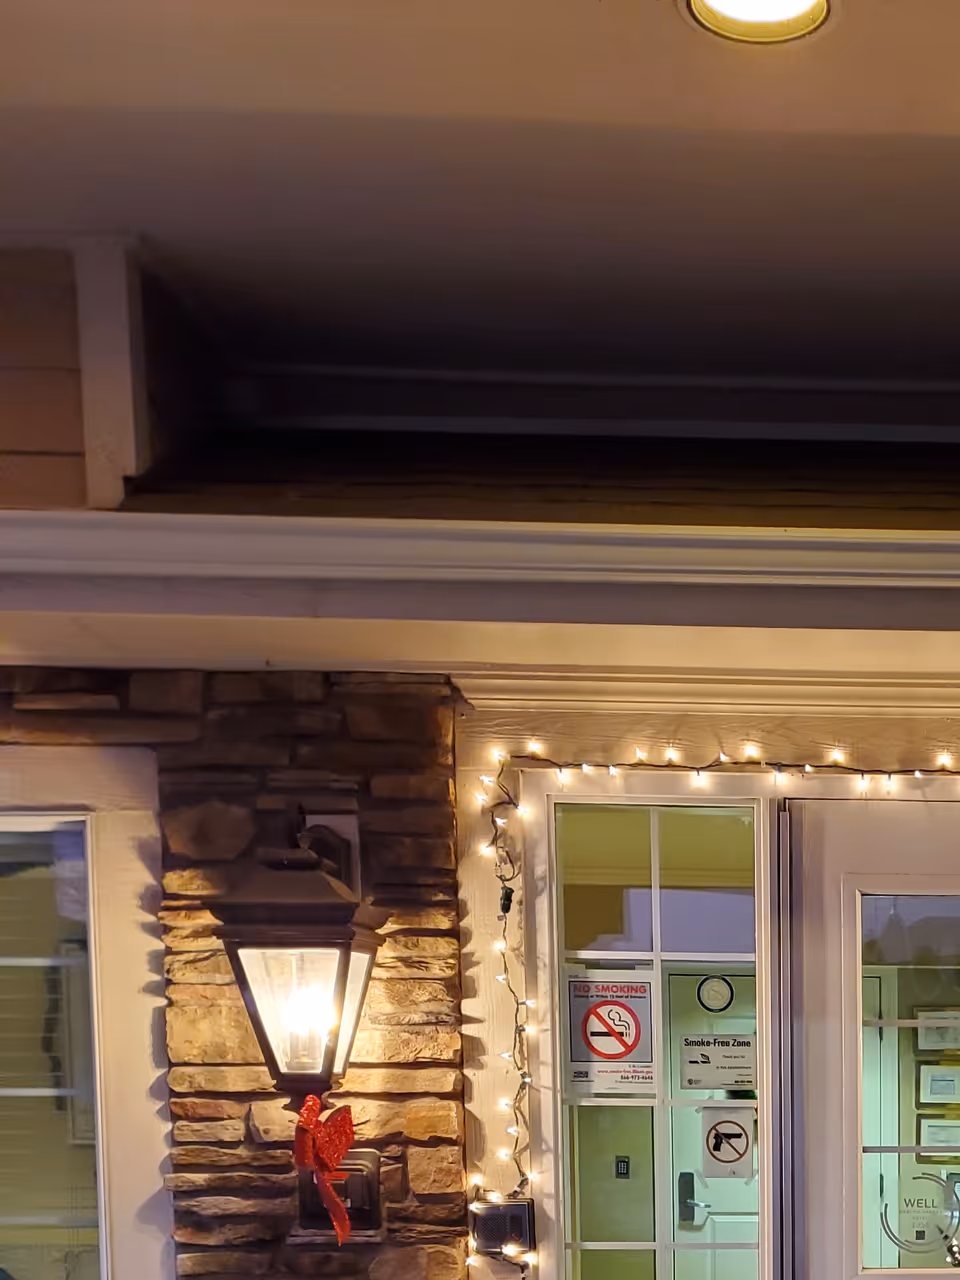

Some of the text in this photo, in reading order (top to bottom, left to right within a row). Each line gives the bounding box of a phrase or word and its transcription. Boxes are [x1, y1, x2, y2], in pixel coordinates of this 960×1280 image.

[574, 984, 647, 994] NO SMOKING
[684, 1038, 751, 1048] Smoke-Free Zone
[903, 1198, 938, 1208] WELL
